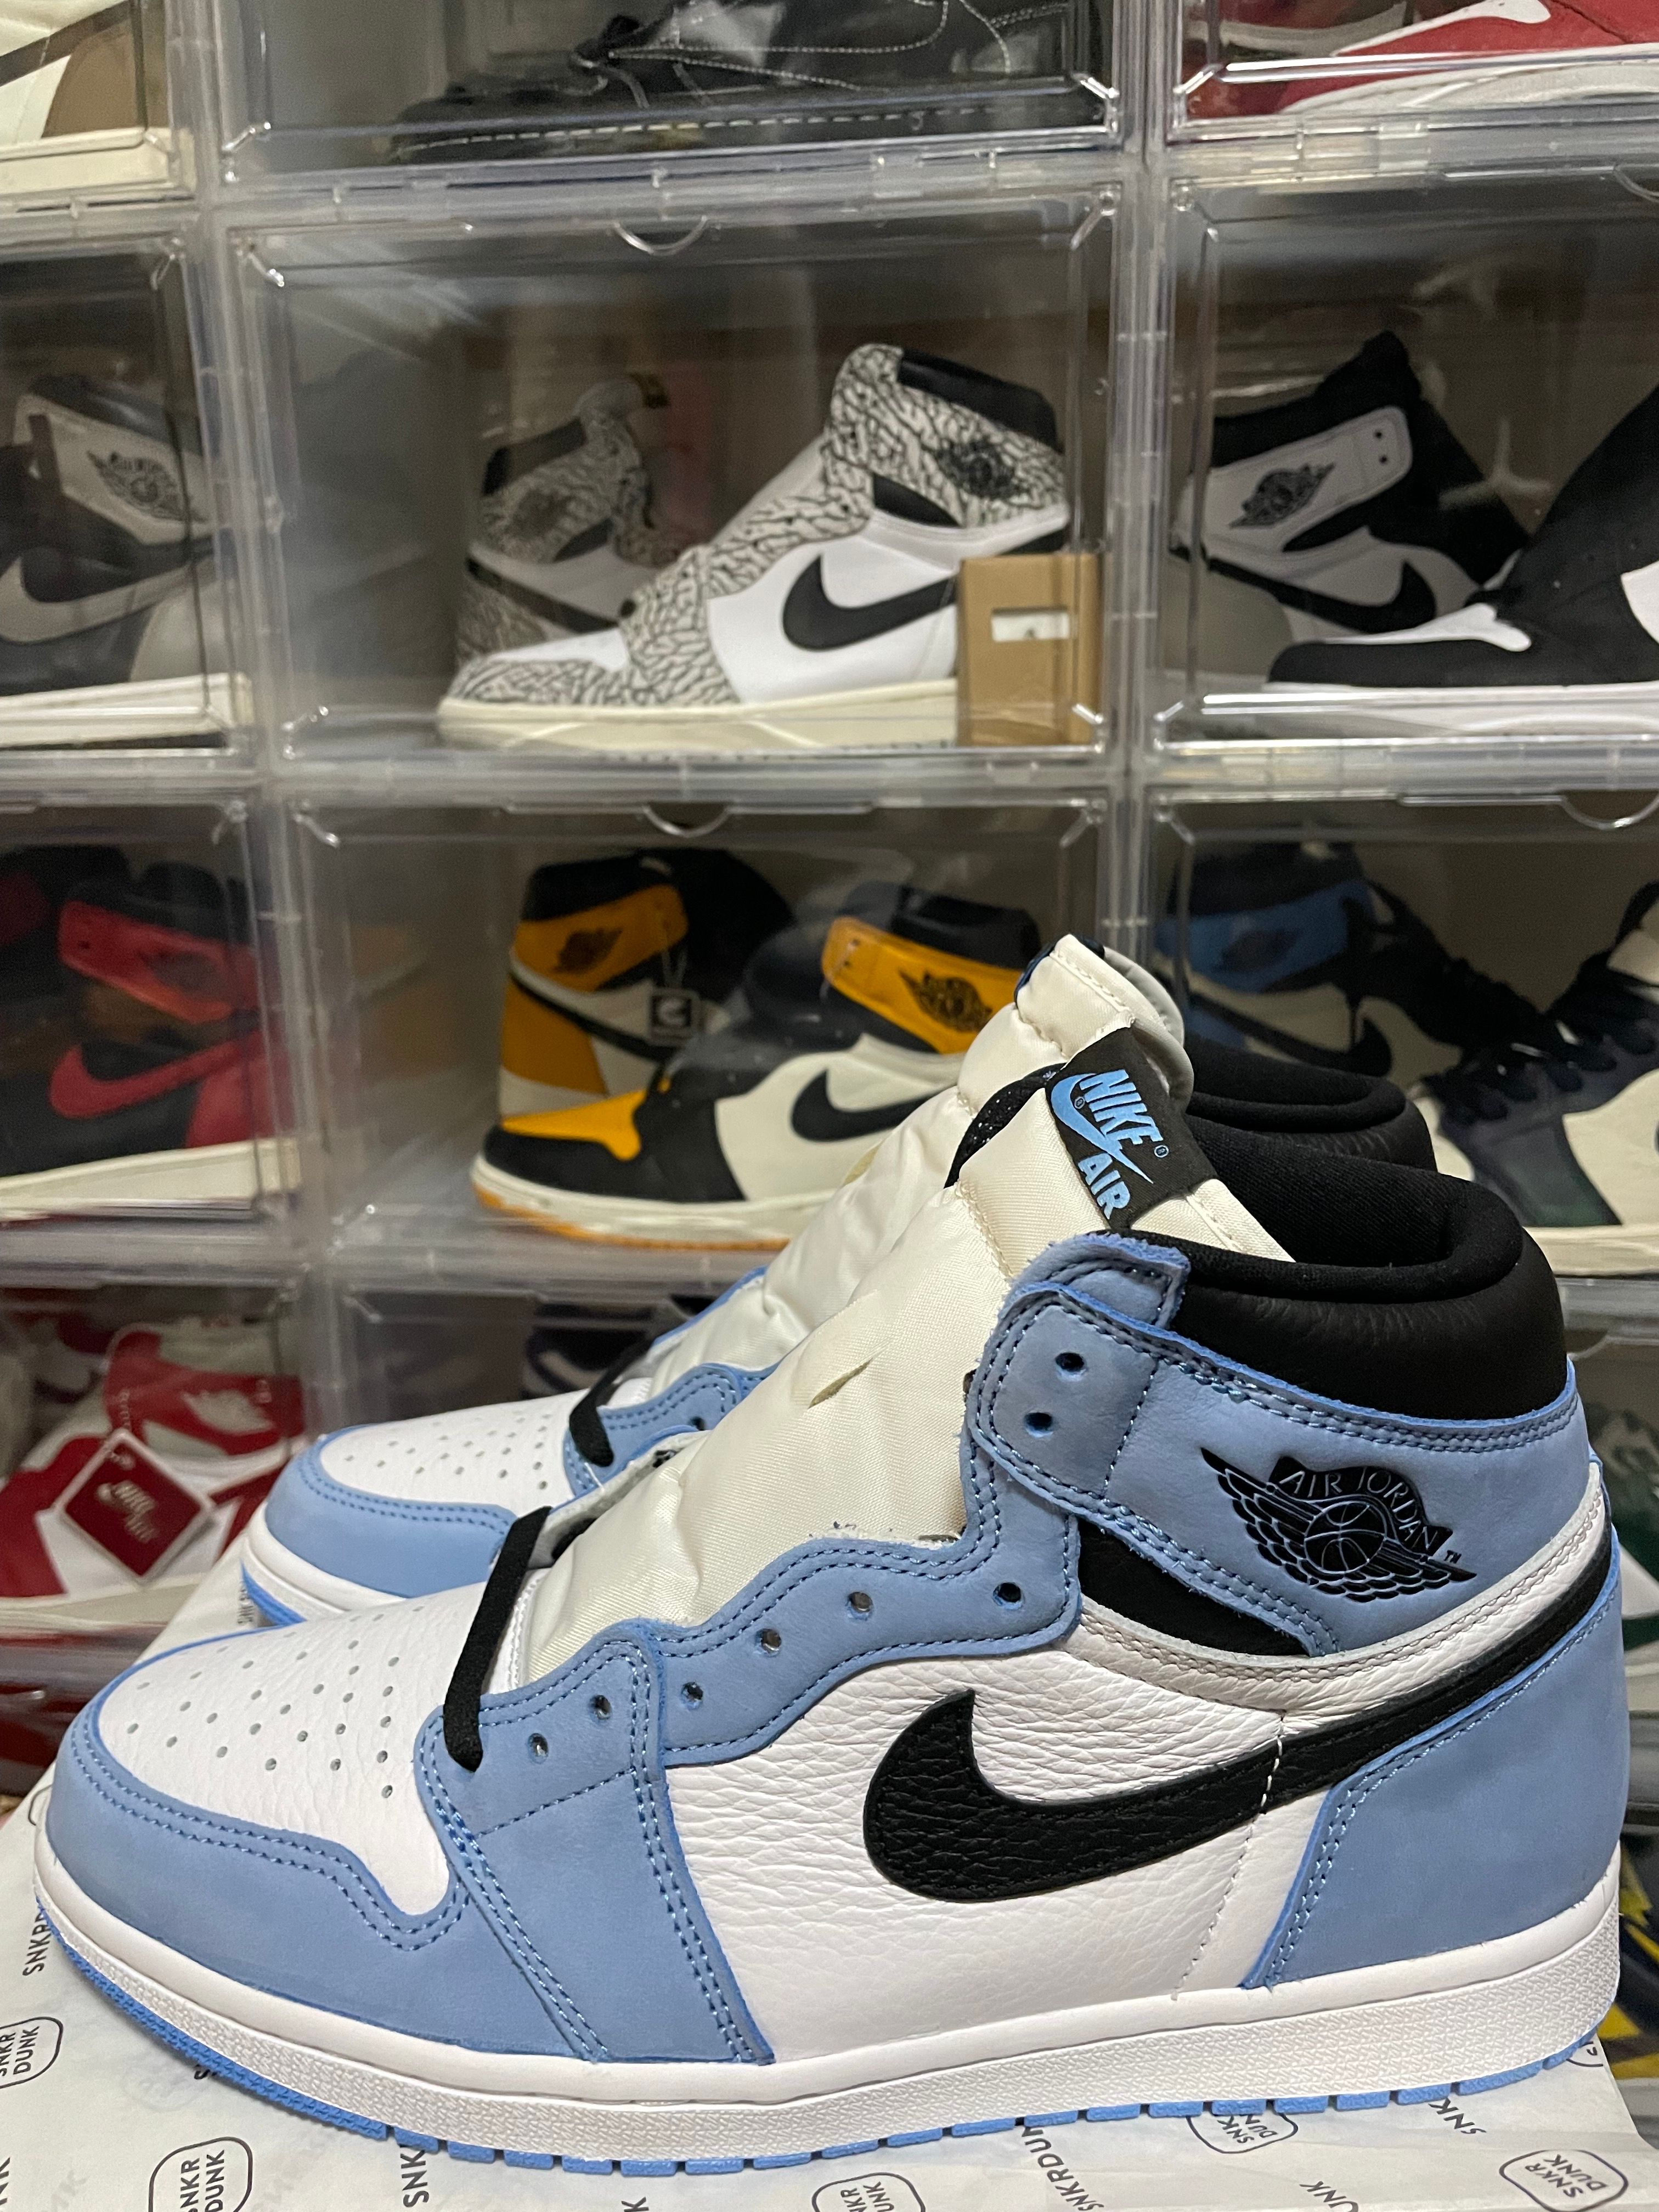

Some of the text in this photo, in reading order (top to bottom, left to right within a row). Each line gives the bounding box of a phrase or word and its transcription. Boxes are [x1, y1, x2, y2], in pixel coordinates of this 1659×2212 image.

[1079, 1069, 1164, 1146] NIKE
[1077, 1154, 1131, 1220] AIR
[1279, 1466, 1438, 1551] AIR JORDAN
[13, 2025, 40, 2075] DUNK
[205, 2149, 225, 2212] DUNK
[1525, 2163, 1584, 2198] SNKR
[1543, 2154, 1608, 2191] DUNK
